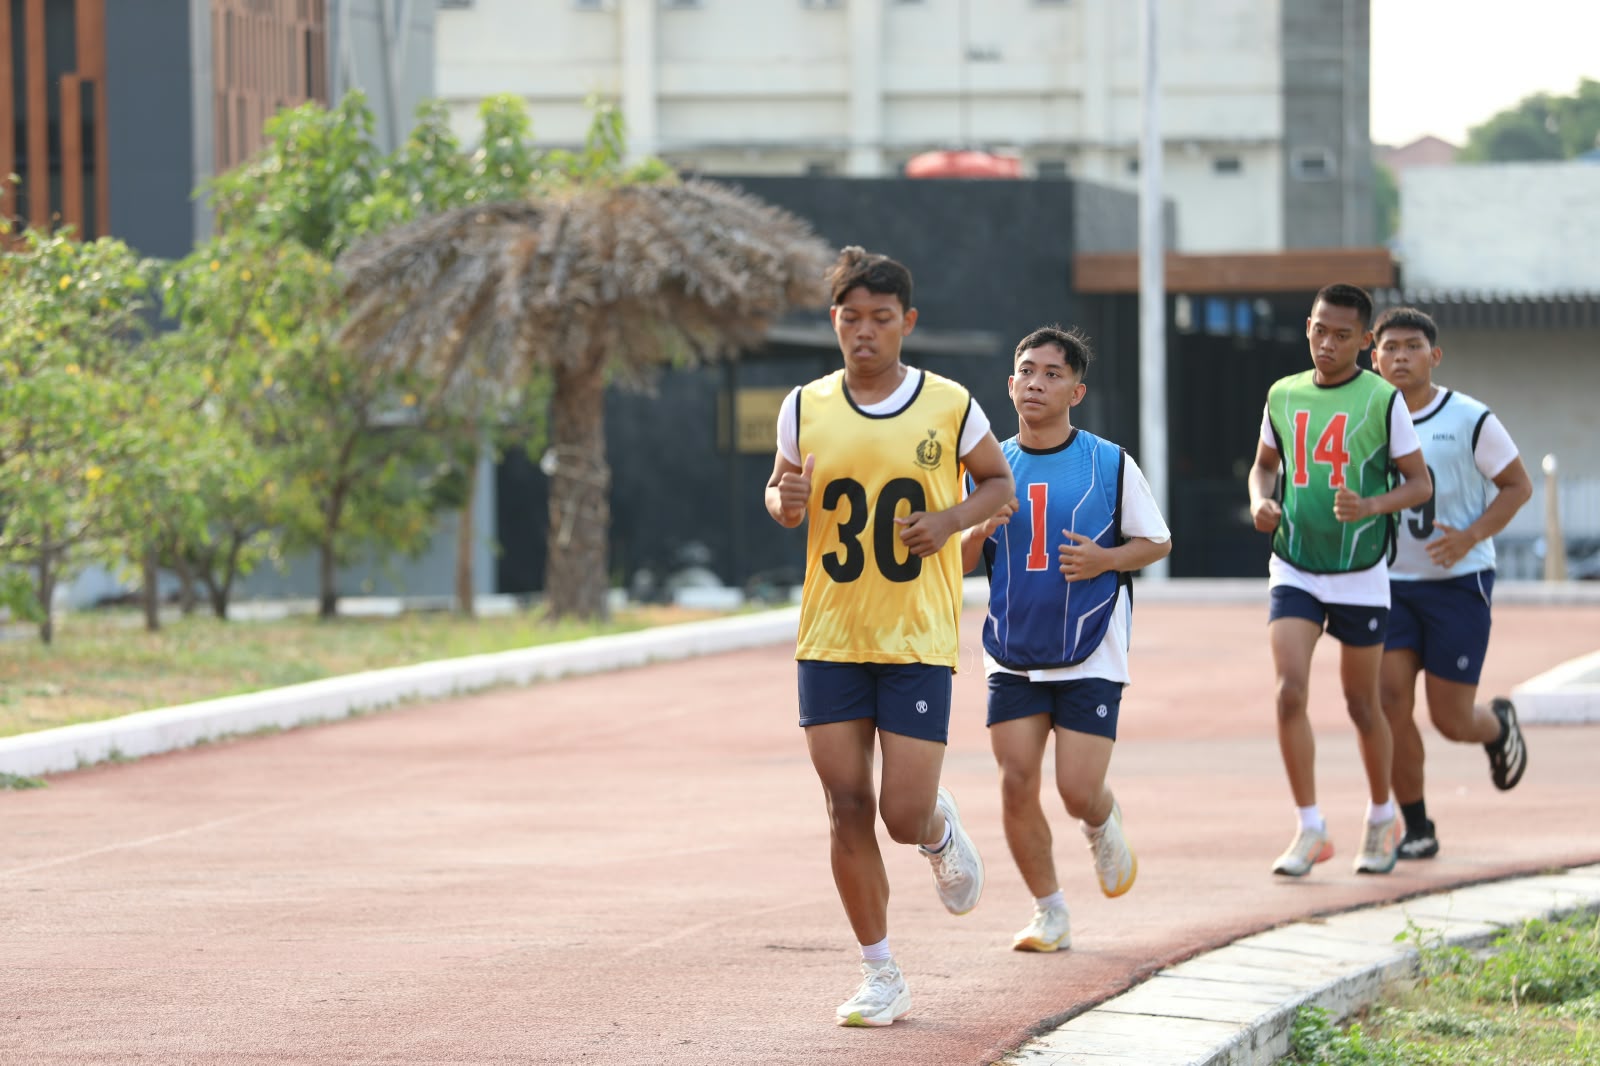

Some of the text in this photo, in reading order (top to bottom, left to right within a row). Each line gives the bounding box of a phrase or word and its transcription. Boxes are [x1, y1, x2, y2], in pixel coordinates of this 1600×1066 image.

[1292, 409, 1350, 489] 14
[821, 477, 927, 584] 30
[1026, 482, 1049, 572] 1
